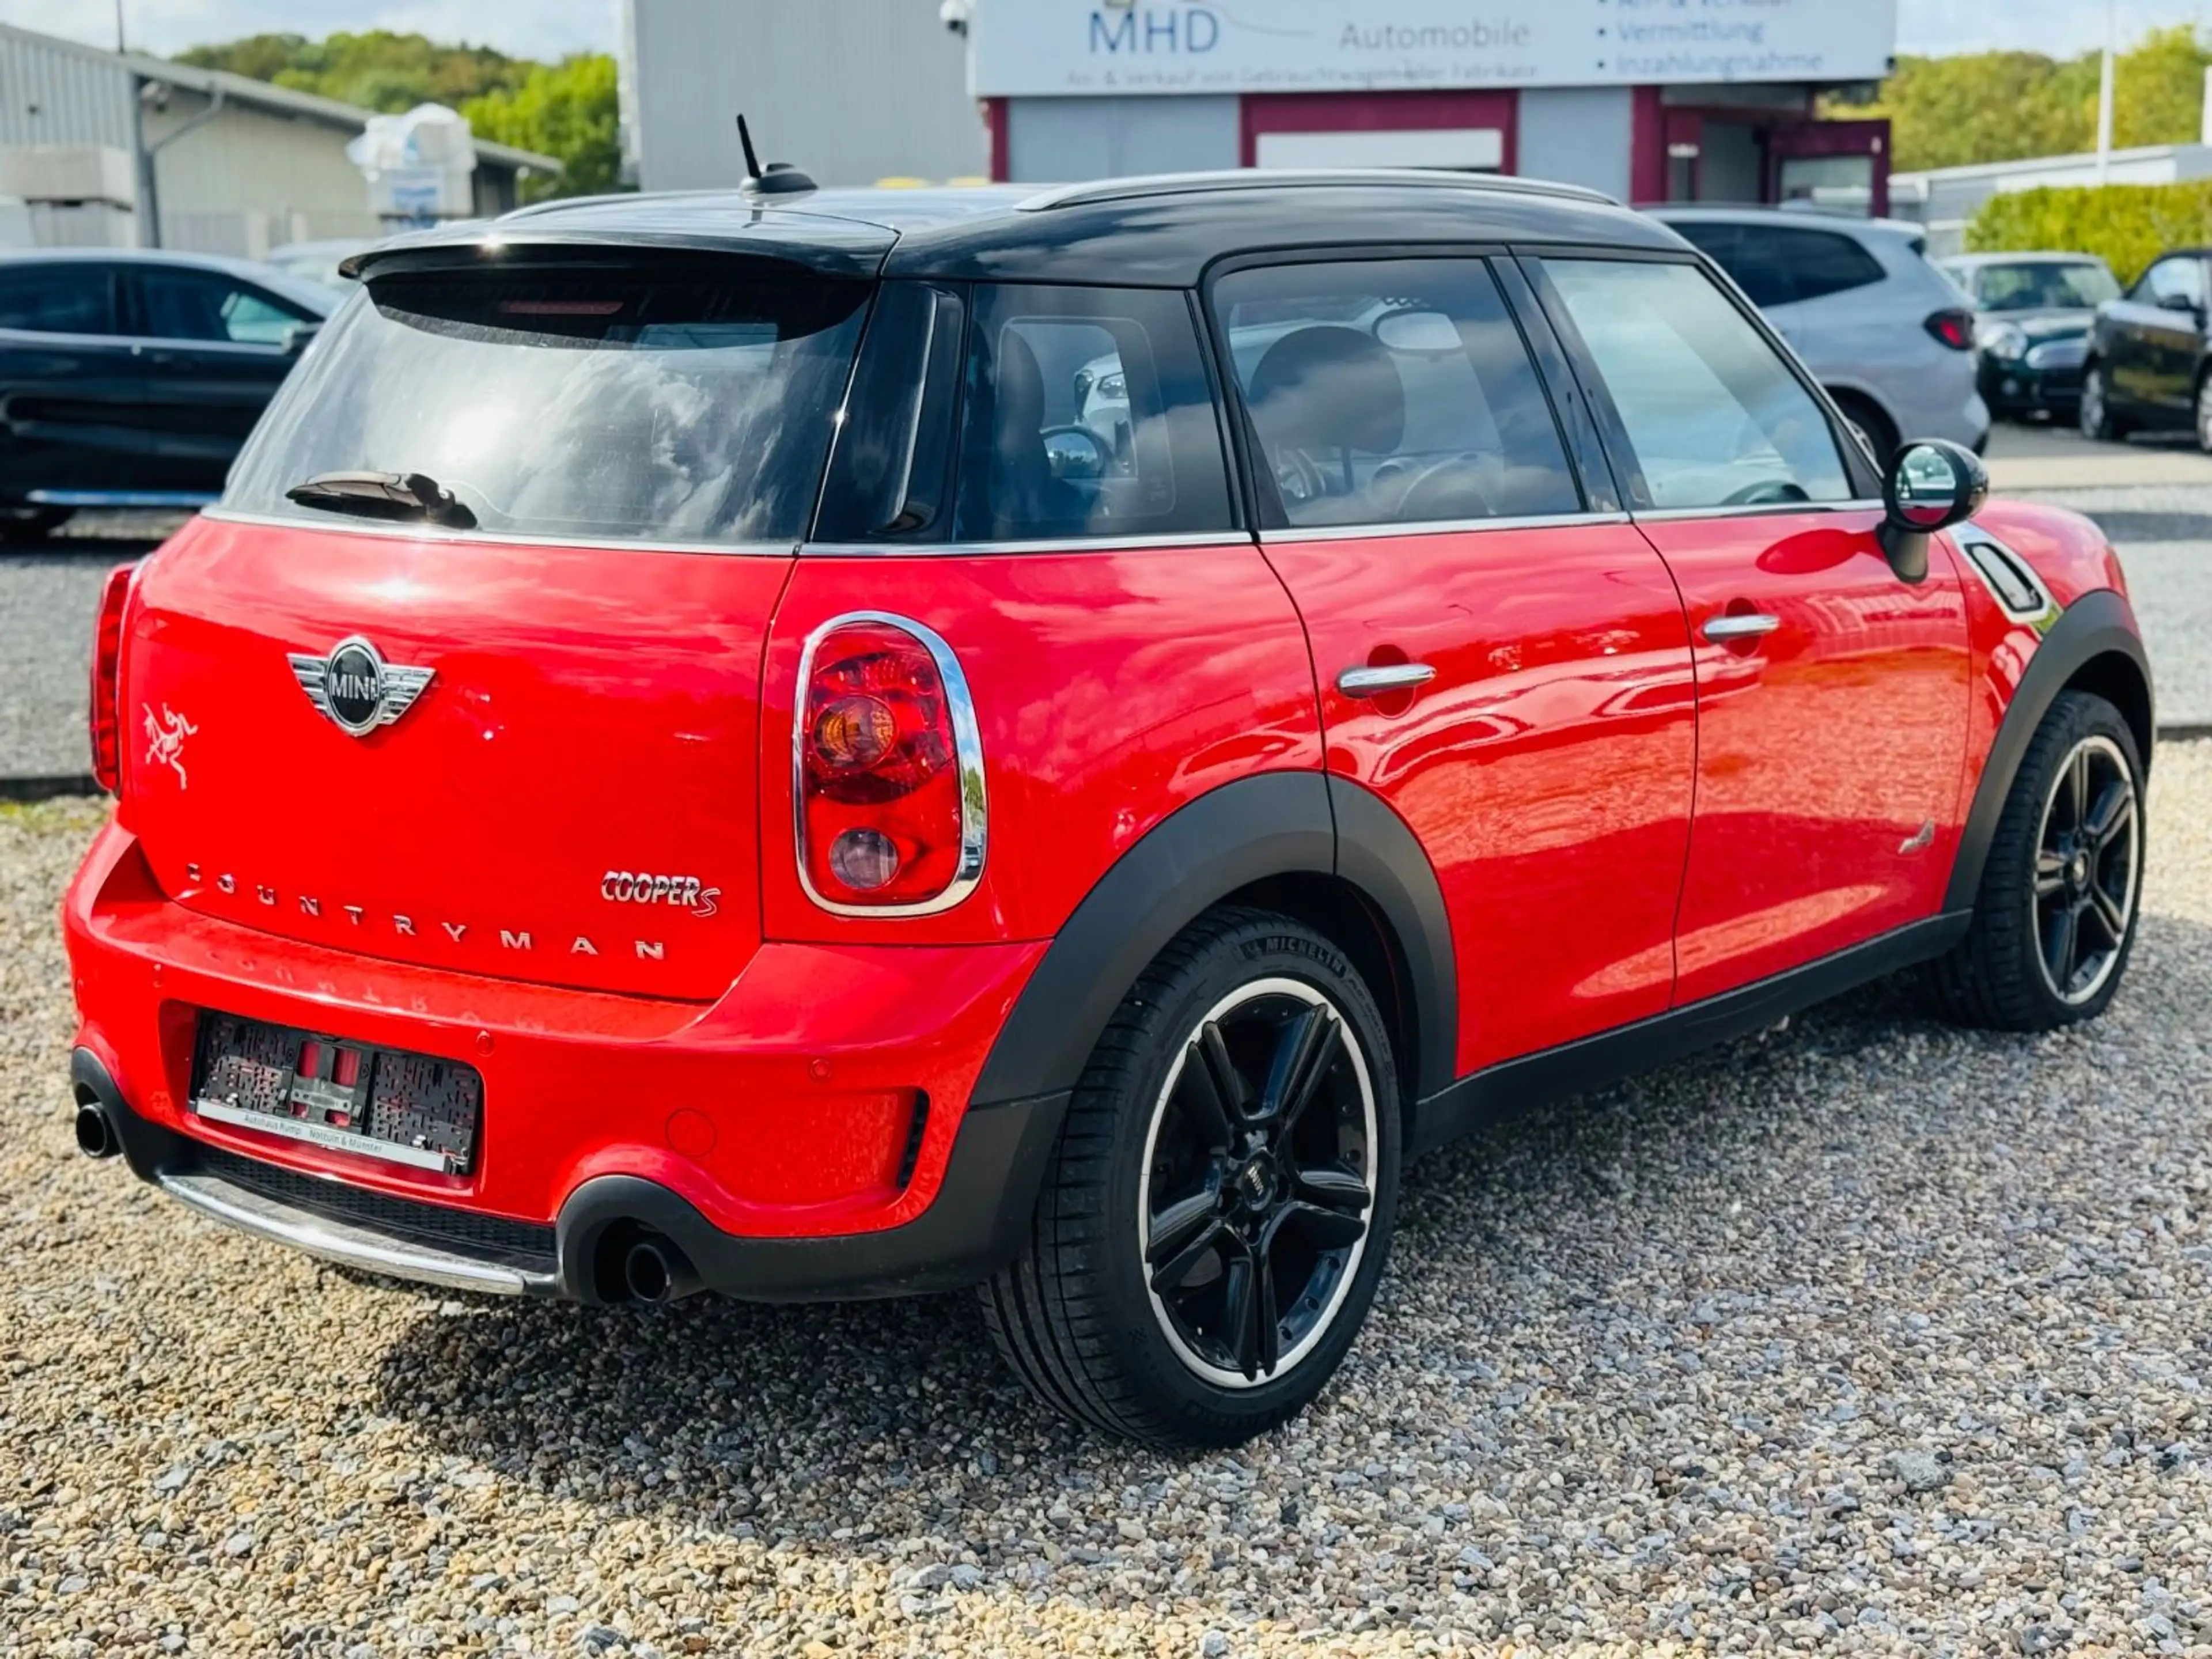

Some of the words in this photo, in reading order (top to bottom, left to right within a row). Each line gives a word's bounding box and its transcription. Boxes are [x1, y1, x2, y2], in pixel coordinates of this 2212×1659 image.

[1088, 9, 1219, 53] MHD
[1339, 17, 1531, 51] Automobile
[1616, 21, 1764, 45] Vermittlung
[1616, 51, 1824, 80] Inzahlungnahme
[331, 672, 378, 702] MINI
[187, 862, 664, 960] COUNTRYMAN
[601, 870, 700, 907] COOPER
[691, 888, 721, 918] S
[1267, 937, 1343, 972] MICHELIN
[245, 1114, 278, 1130] Autohaus
